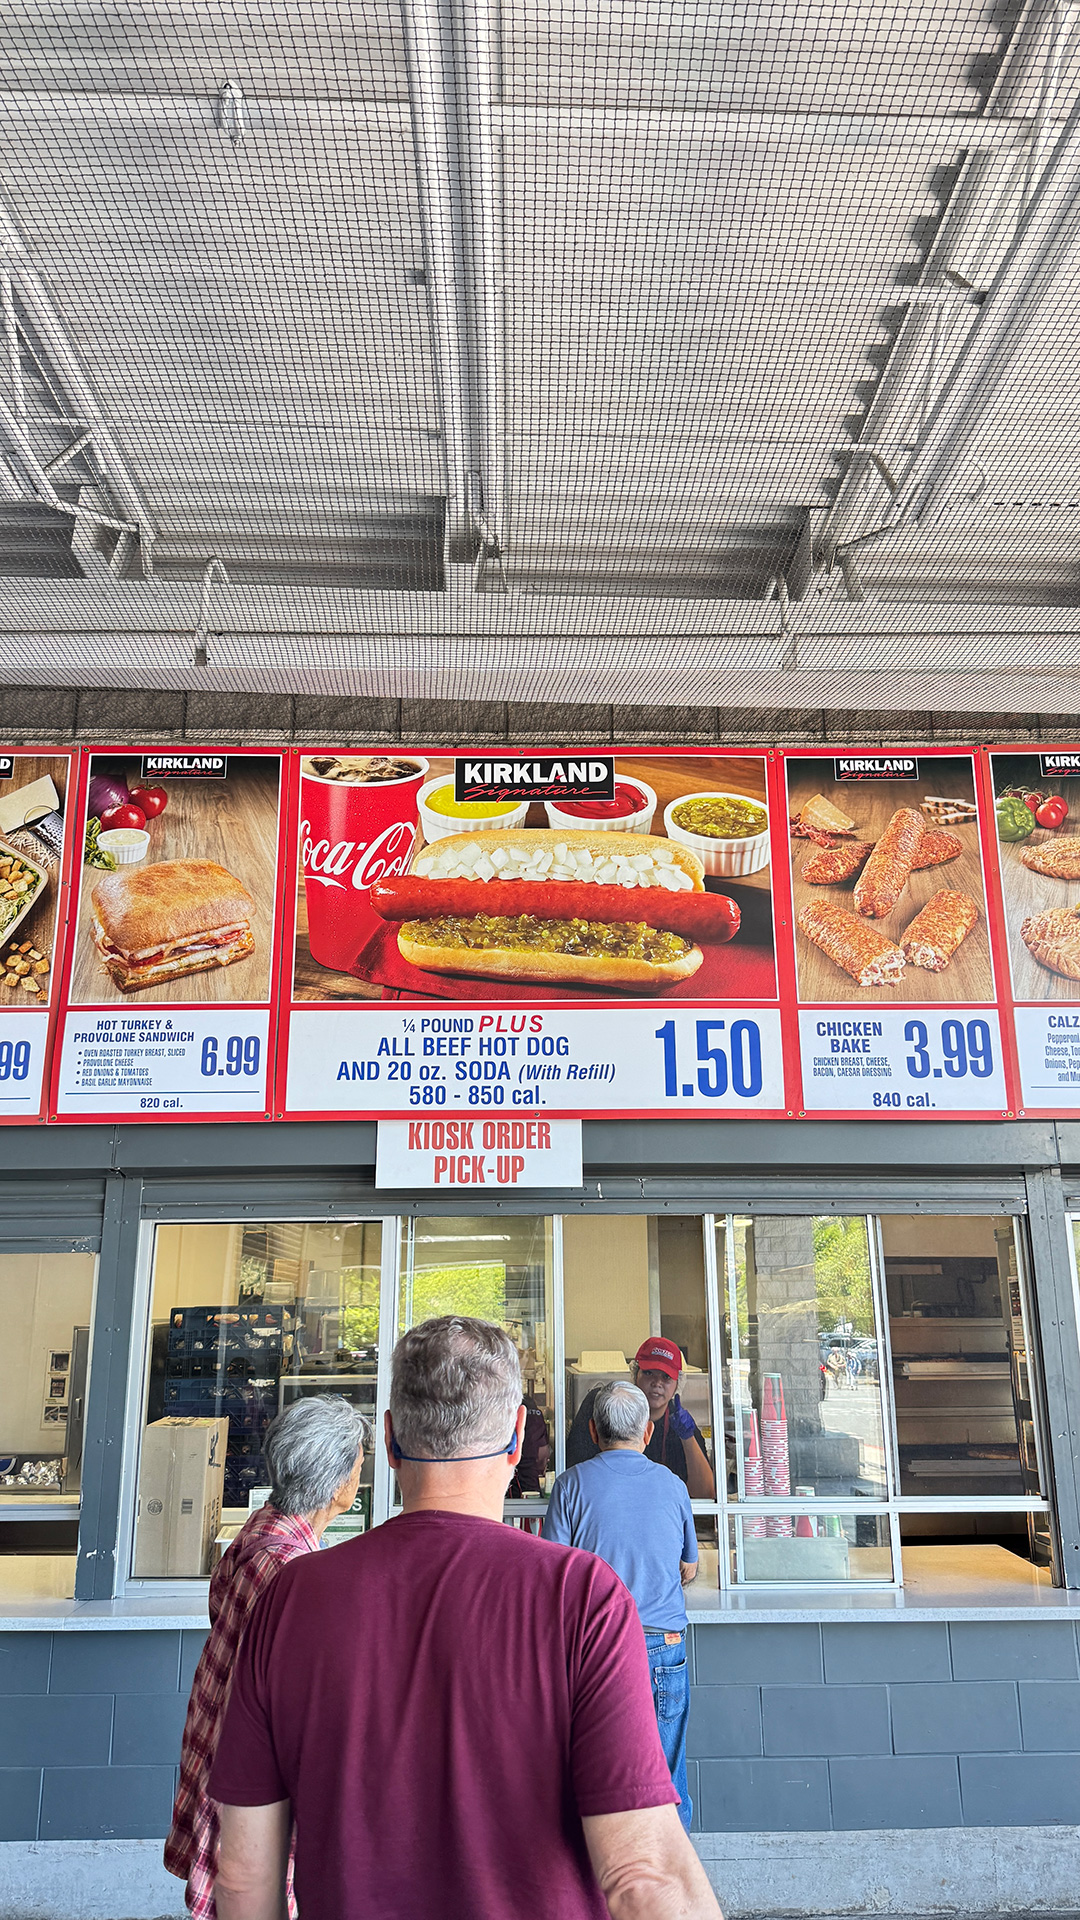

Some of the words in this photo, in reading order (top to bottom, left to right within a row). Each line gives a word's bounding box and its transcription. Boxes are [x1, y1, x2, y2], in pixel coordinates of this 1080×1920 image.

[147, 757, 223, 769] KIRKLAND
[839, 760, 915, 771] KIRKLAND
[146, 769, 223, 778] Signature
[464, 762, 609, 784] KIRKLAND
[840, 770, 915, 780] Signature
[463, 783, 609, 803] Signature
[97, 1020, 118, 1030] HOT
[121, 1020, 162, 1030] TURKEY
[165, 1020, 173, 1030] &
[421, 1018, 474, 1033] POUND
[479, 1015, 543, 1033] PLUS
[816, 1022, 882, 1036] CHICKEN
[74, 1032, 136, 1043] PROVOLONE
[138, 1031, 195, 1042] SANDWICH
[84, 1049, 98, 1057] OVEN
[99, 1049, 123, 1057] ROASTED
[124, 1048, 144, 1057] TURKEY
[145, 1048, 166, 1057] BREAST,
[167, 1048, 186, 1056] SLICED
[377, 1037, 415, 1056] ALL
[423, 1037, 472, 1056] BEEF
[479, 1037, 519, 1056] HOT
[527, 1037, 570, 1056] DOG
[831, 1039, 871, 1053] BAKE
[904, 1020, 994, 1078] 3.99
[83, 1059, 114, 1067] PROVOLONE
[115, 1058, 134, 1067] CHEESE
[201, 1036, 260, 1076] 6.99
[655, 1020, 762, 1097] 1.50
[813, 1057, 839, 1066] CHICKEN
[840, 1057, 865, 1067] BREAST,
[866, 1057, 890, 1067] CHEESE,
[82, 1068, 92, 1076] RED
[93, 1068, 114, 1076] ONIONS
[115, 1068, 119, 1076] &
[121, 1068, 149, 1076] TOMATOES
[336, 1061, 380, 1081] AND
[387, 1061, 411, 1081] 20
[419, 1065, 446, 1081] oz.
[455, 1061, 511, 1081] SODA
[518, 1063, 561, 1084] (With
[566, 1063, 616, 1084] Refill)
[813, 1067, 836, 1077] BACON,
[837, 1067, 860, 1076] CAESAR
[862, 1067, 892, 1076] DRESSING
[1057, 1071, 1070, 1082] and
[81, 1078, 96, 1086] BASIL
[98, 1078, 116, 1086] GARLIC
[118, 1078, 152, 1086] MAYONNAISE
[409, 1085, 446, 1105] 580
[468, 1085, 505, 1105] 850
[512, 1086, 546, 1105] cal.
[873, 1093, 900, 1107] 840
[906, 1093, 936, 1107] cal.
[140, 1098, 160, 1108] 820
[163, 1097, 183, 1108] cal.
[408, 1122, 474, 1150] KIOSK
[482, 1121, 551, 1150] ORDER
[434, 1155, 525, 1184] PICK-UP
